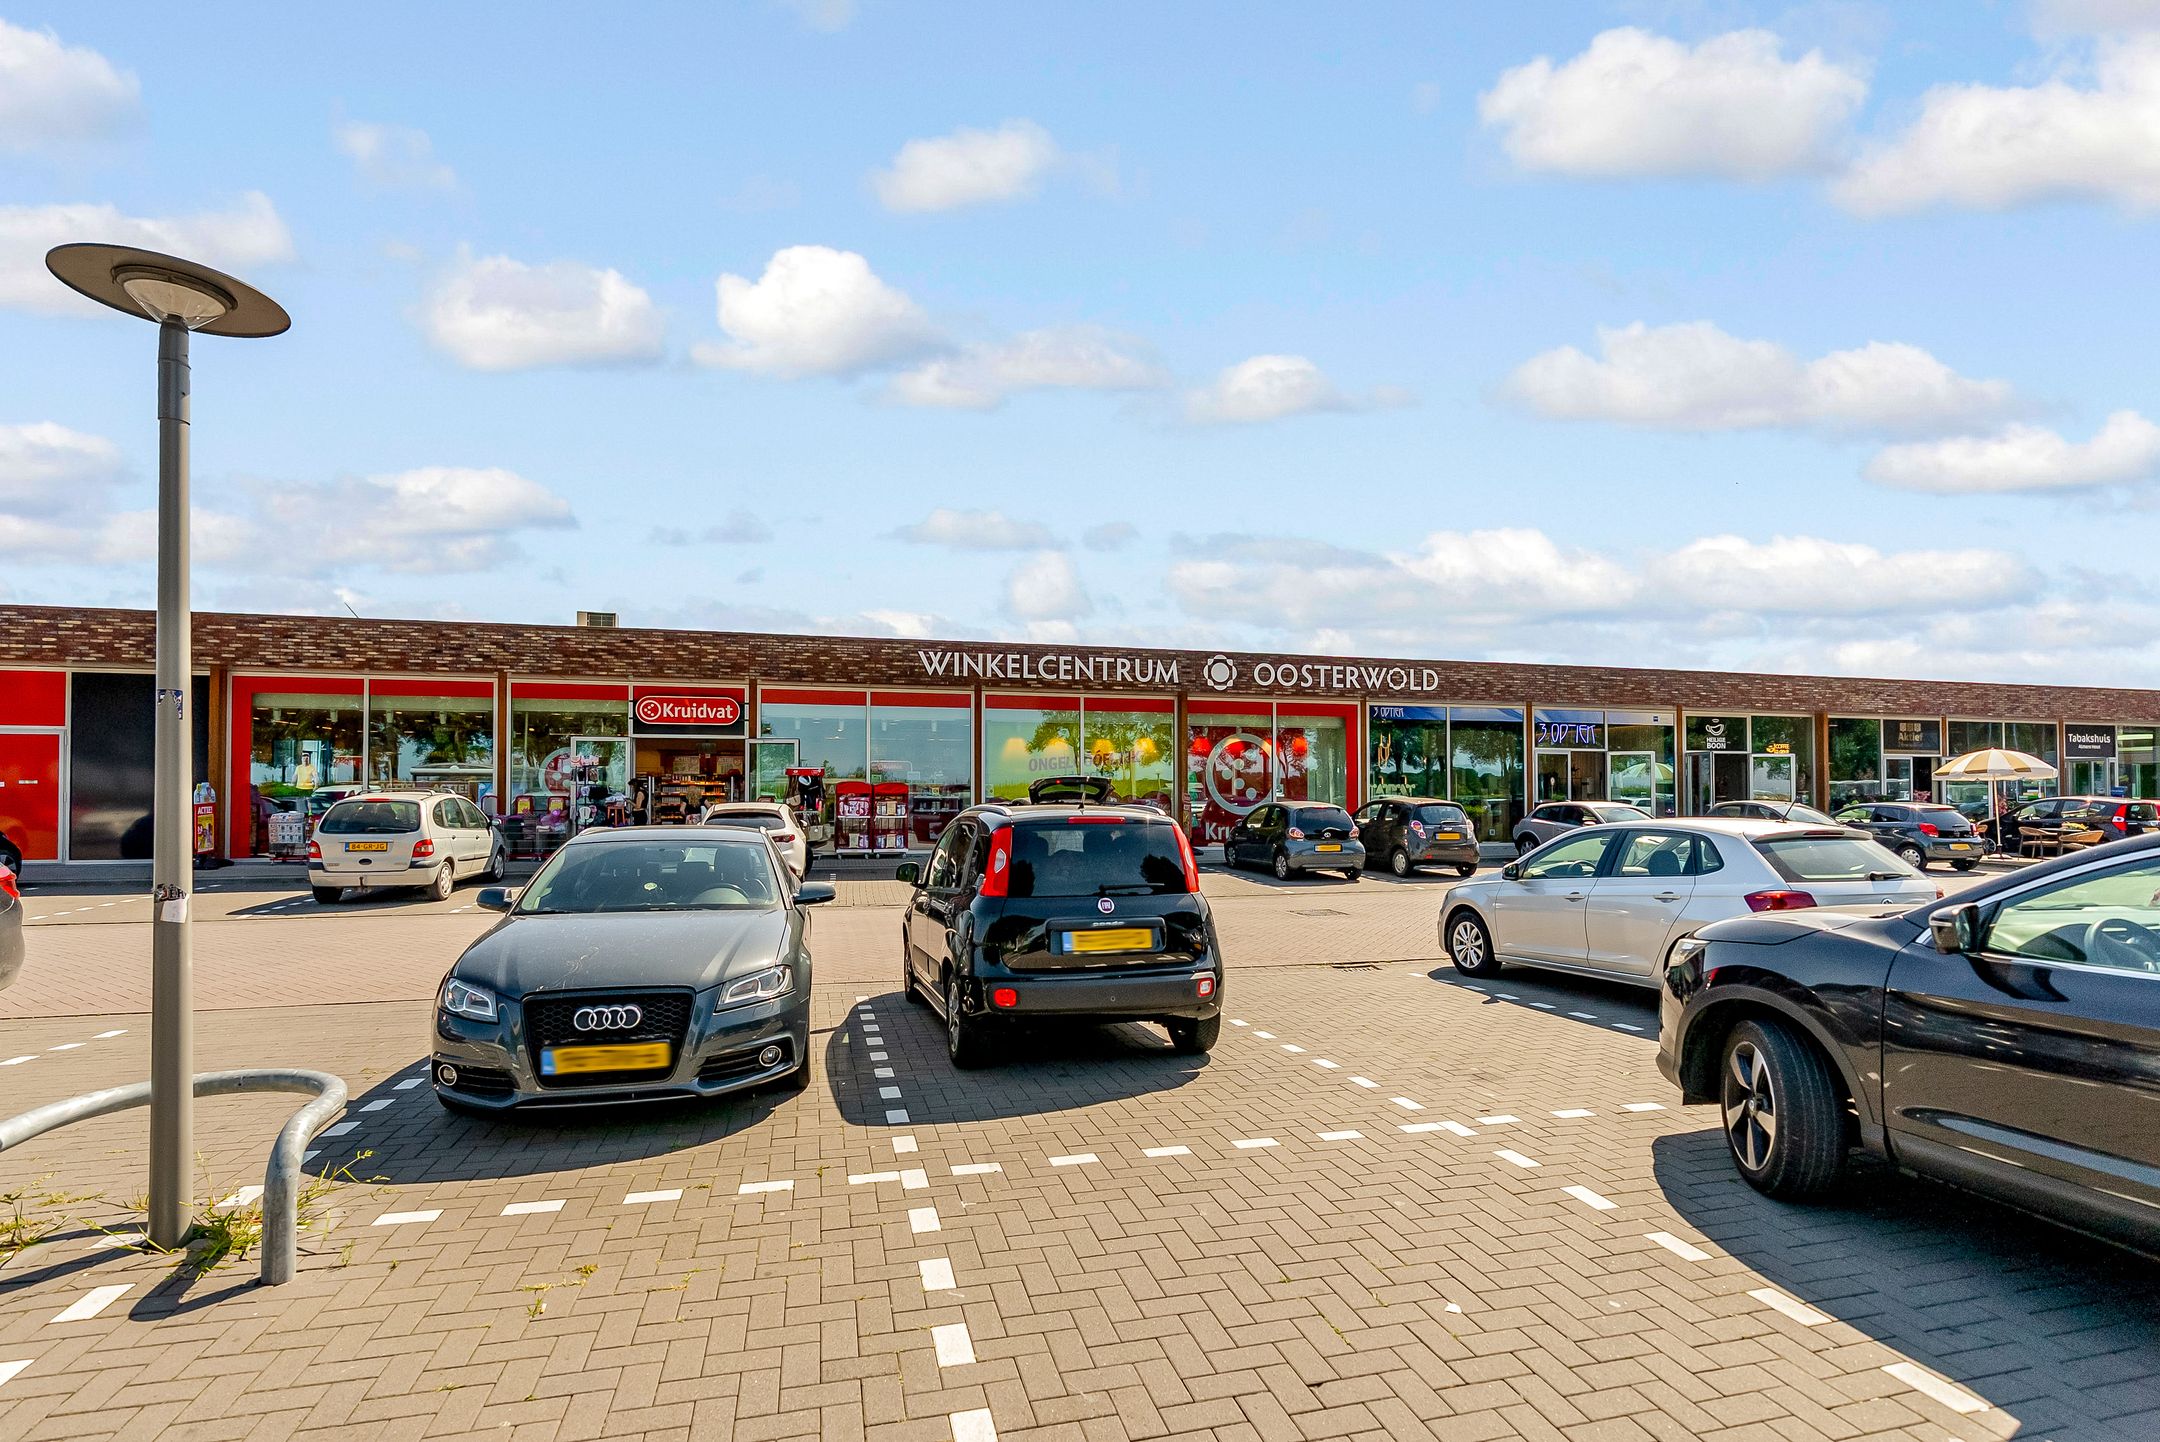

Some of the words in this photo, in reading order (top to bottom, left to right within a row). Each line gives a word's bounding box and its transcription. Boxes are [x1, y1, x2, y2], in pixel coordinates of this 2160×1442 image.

[918, 651, 1180, 684] WINKELCENTRUM
[1253, 662, 1438, 691] OOSTERWOLD
[662, 702, 734, 719] Kruidvat
[2068, 733, 2111, 744] Tabakshuis
